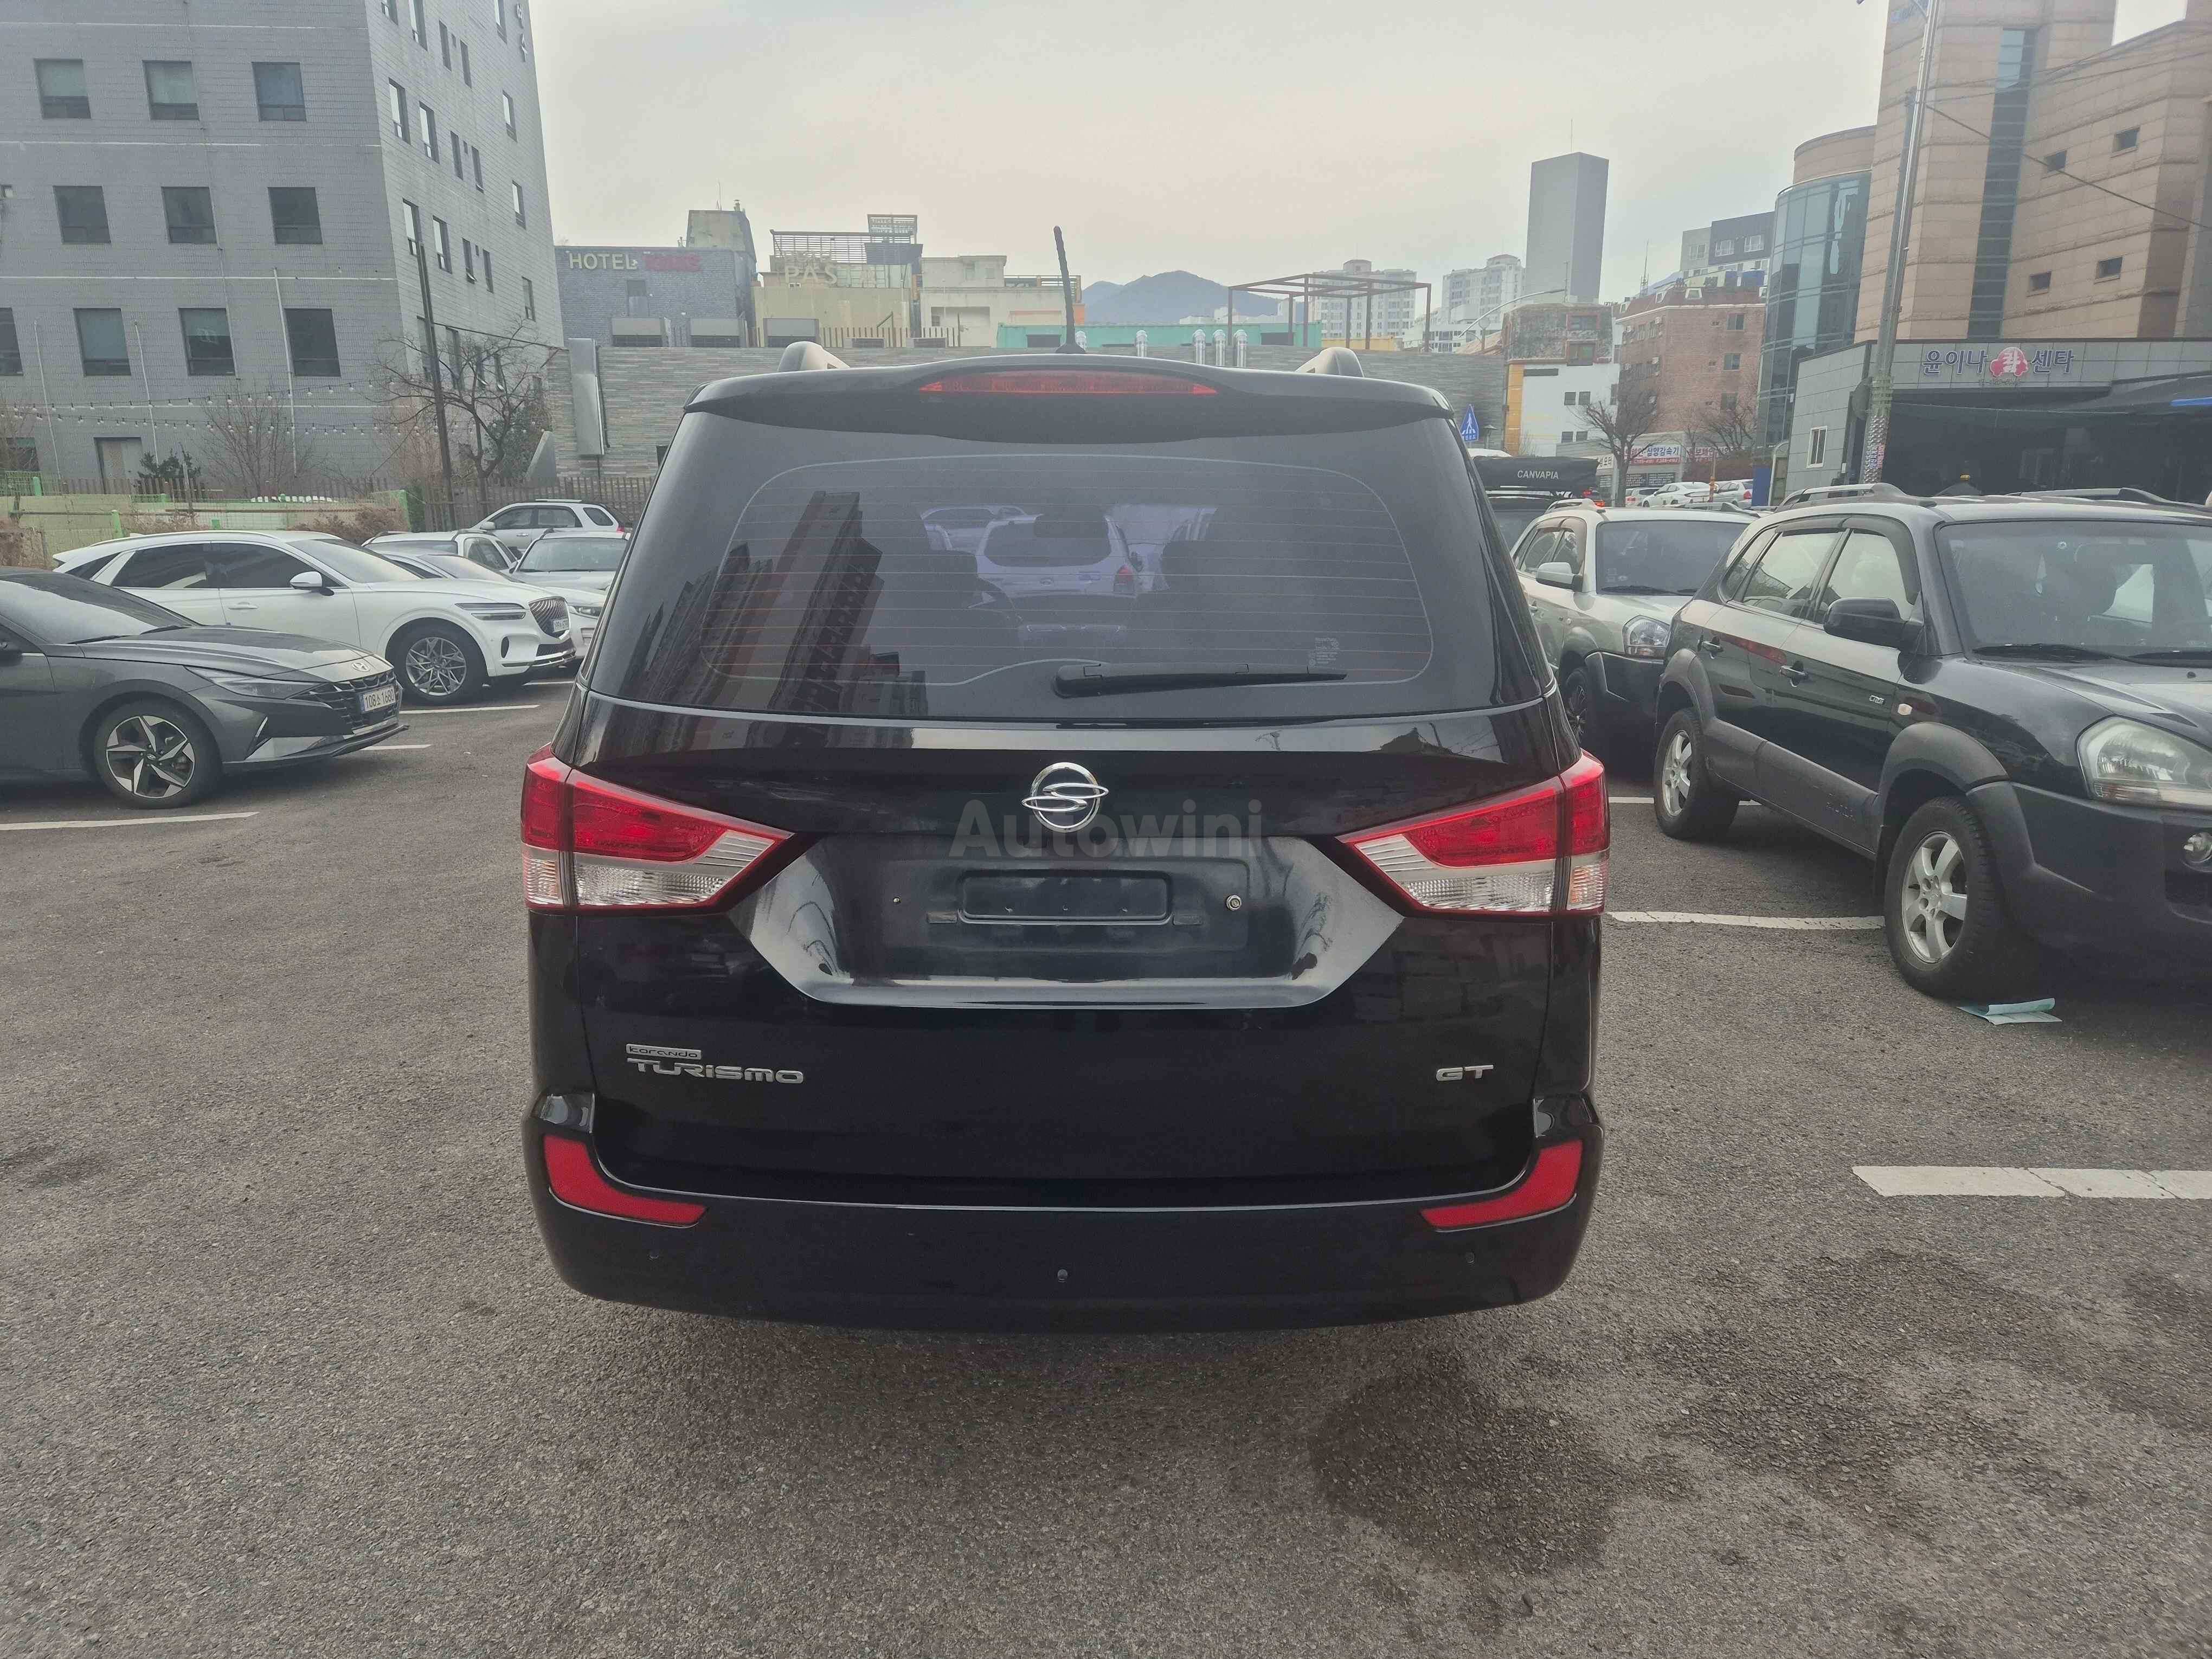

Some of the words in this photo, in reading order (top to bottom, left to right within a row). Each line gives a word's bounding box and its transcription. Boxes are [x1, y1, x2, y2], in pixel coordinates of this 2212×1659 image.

[569, 253, 638, 270] HOTEL
[1922, 350, 1988, 374] 윤이나
[2031, 350, 2075, 374] 센타
[1517, 470, 1559, 479] CANVAPIA
[629, 1046, 698, 1058] korando
[627, 1058, 804, 1084] TURISMO
[1436, 1064, 1494, 1082] GT
